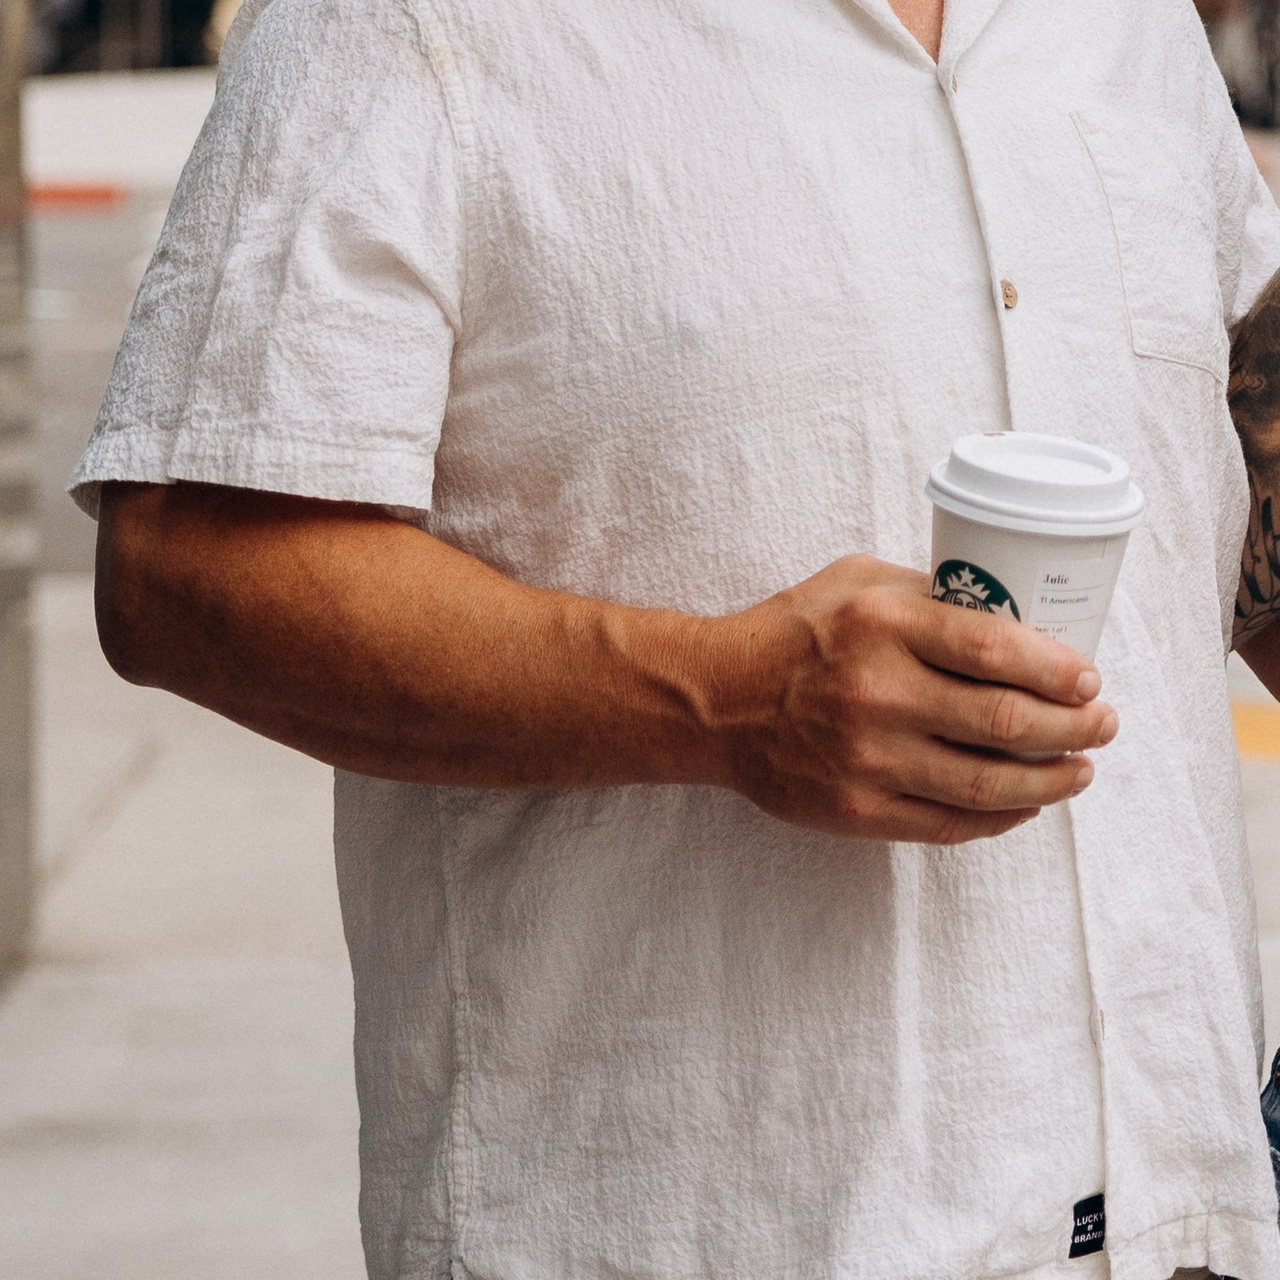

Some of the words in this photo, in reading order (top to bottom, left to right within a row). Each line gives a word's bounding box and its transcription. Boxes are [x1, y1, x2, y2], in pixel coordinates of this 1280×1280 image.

[1049, 597, 1089, 605] Americano
[1076, 1212, 1104, 1226] LUCKY
[1074, 1231, 1103, 1243] BRAND
